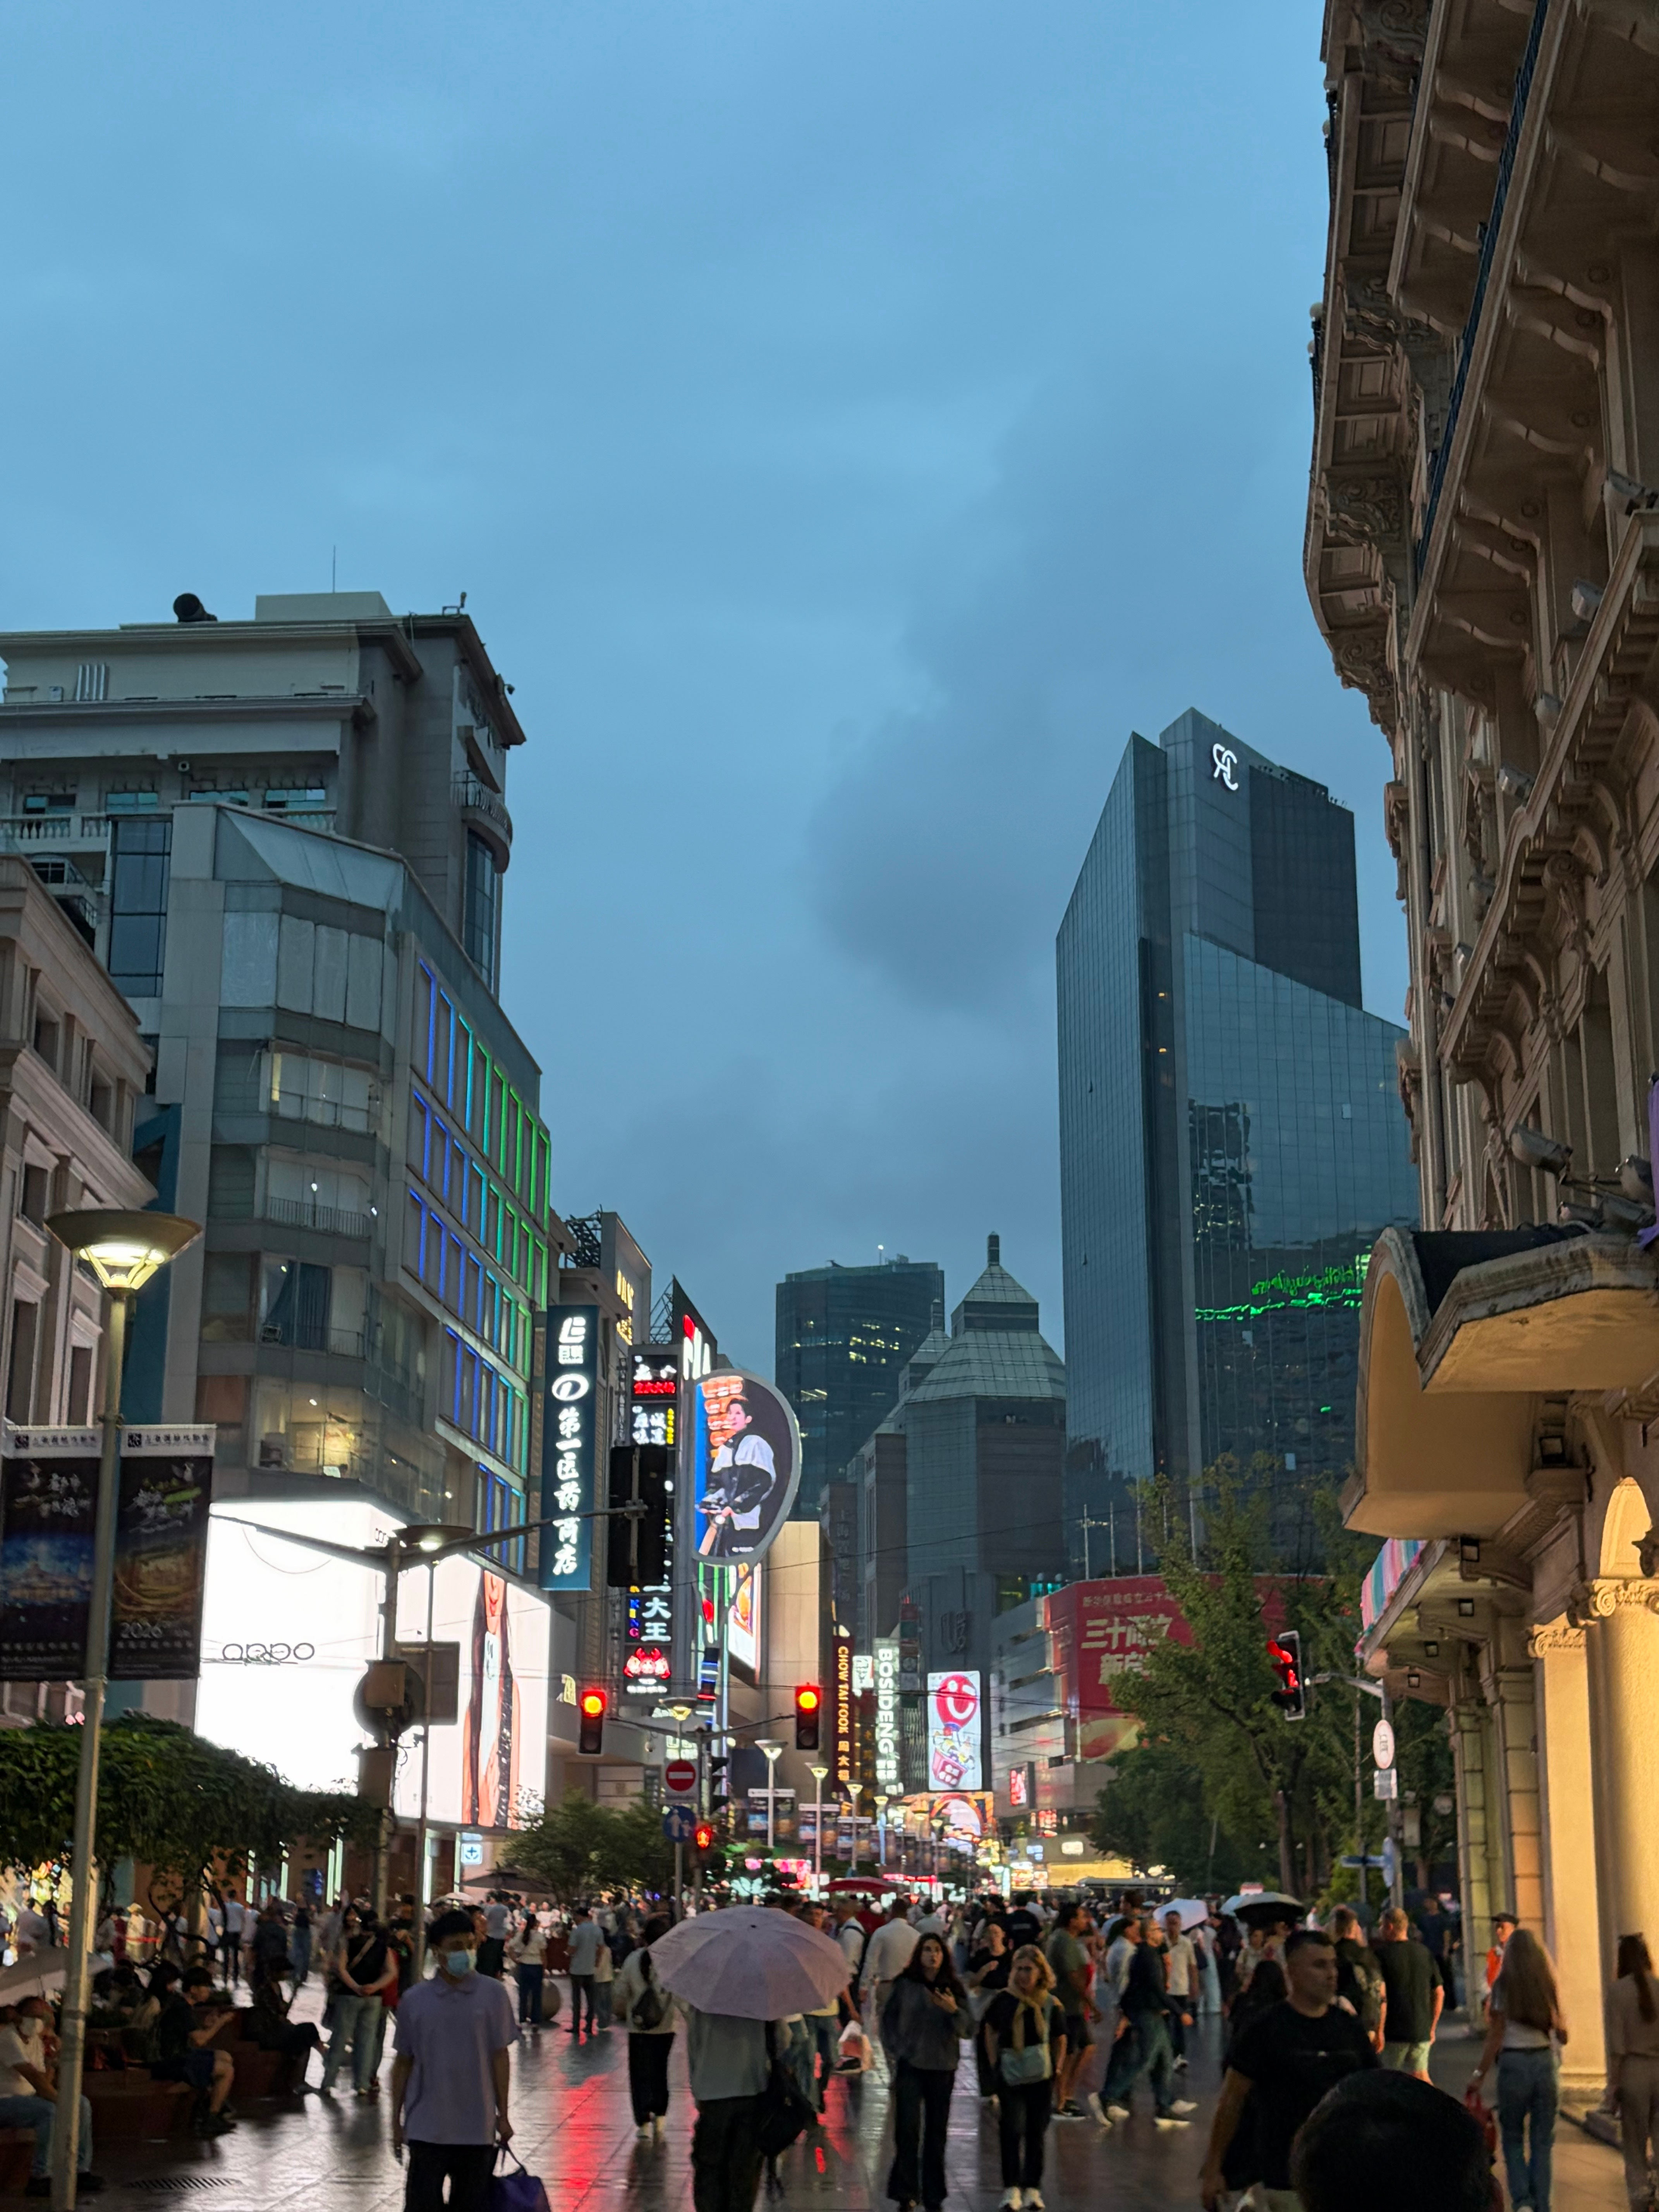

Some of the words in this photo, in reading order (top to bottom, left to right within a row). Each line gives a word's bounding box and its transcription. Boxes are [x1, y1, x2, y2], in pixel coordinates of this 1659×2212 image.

[553, 1407, 582, 1575] 第一医药商店
[838, 1646, 849, 1681] CHOW
[838, 1683, 849, 1700] TAI
[878, 1648, 895, 1754] BOSIDENG
[838, 1703, 849, 1733] FOOK
